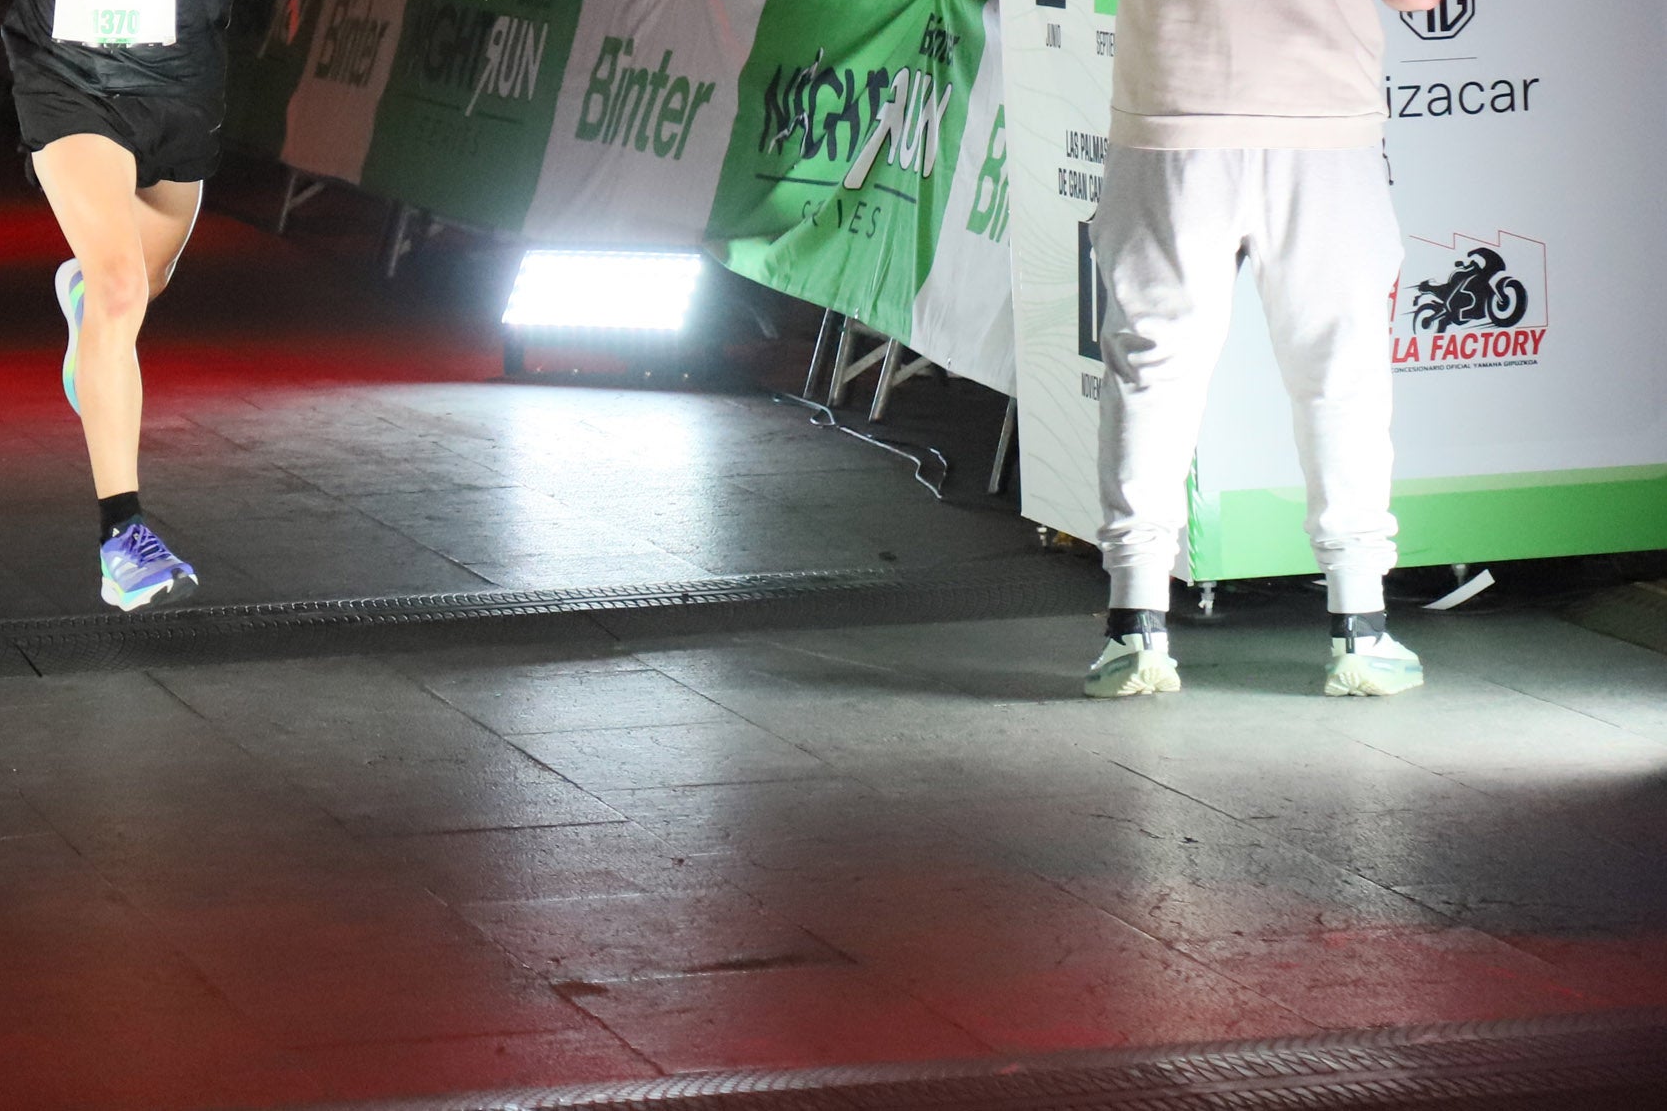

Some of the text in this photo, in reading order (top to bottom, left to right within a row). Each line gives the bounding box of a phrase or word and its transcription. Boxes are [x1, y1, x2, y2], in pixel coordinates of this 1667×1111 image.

[92, 8, 141, 35] 1370
[575, 35, 716, 161] Binter
[1386, 75, 1540, 118] izacar
[1066, 129, 1078, 159] LAS
[1069, 170, 1087, 201] GRAN
[1089, 174, 1103, 203] CAN
[1430, 328, 1546, 361] FACTORY
[1446, 362, 1471, 371] OFICIAL
